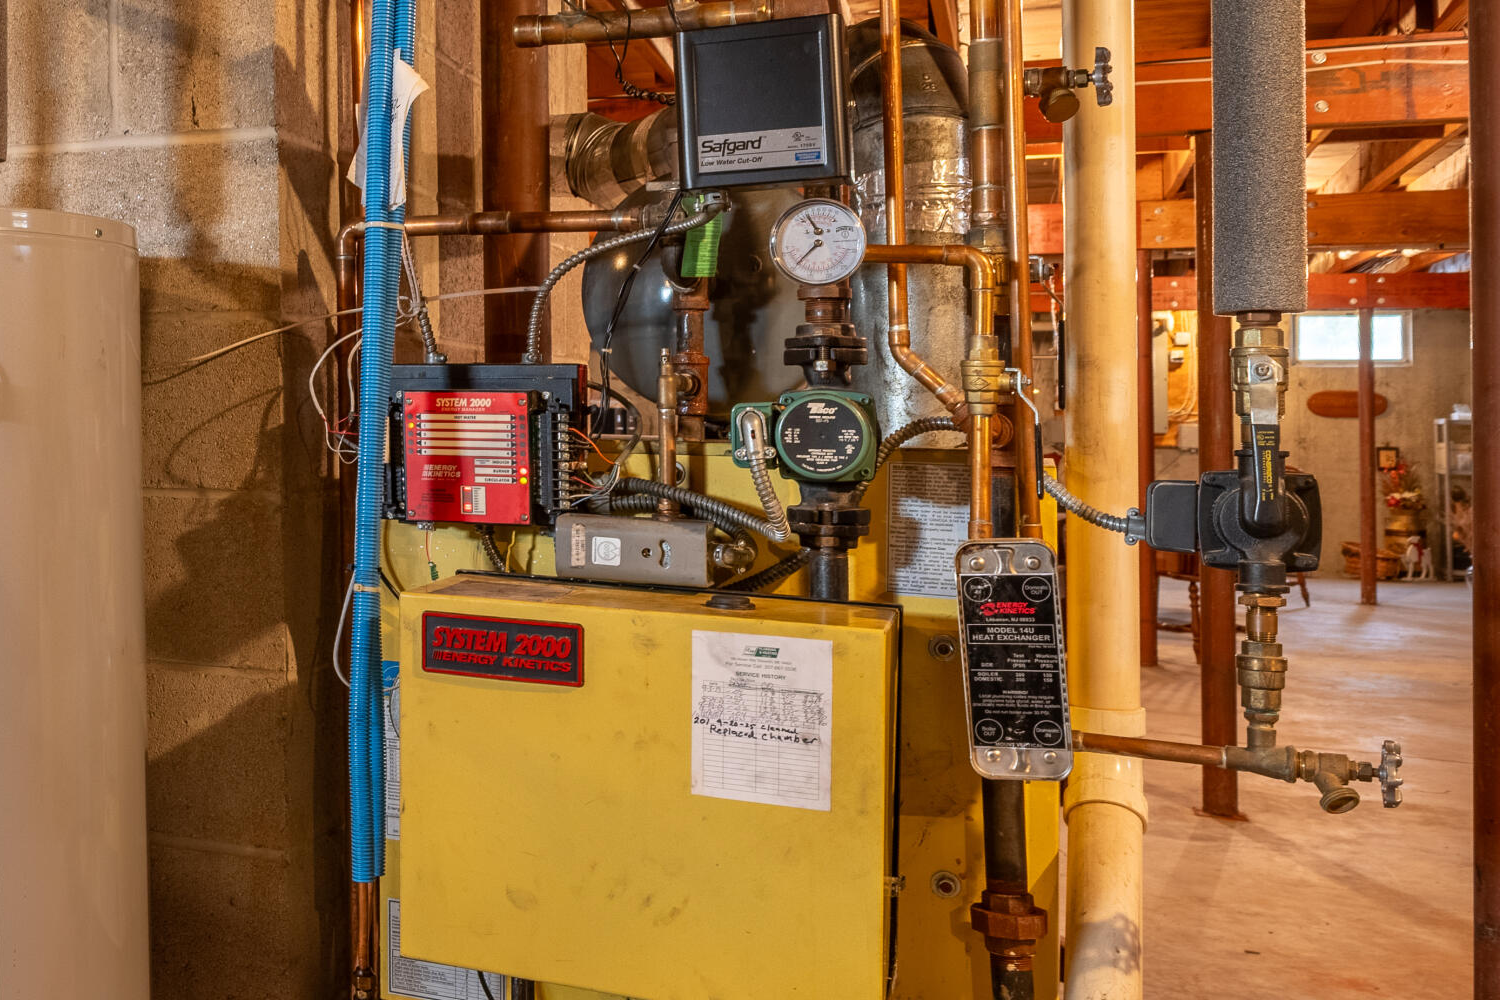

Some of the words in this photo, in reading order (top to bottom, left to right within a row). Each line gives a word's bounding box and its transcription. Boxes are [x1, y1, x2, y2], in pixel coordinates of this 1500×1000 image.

[701, 136, 762, 156] Safgard
[738, 156, 763, 164] Cut-Off
[436, 398, 467, 408] SYSTEM
[470, 399, 491, 408] 2000
[432, 626, 508, 653] SYSTEM
[514, 633, 572, 659] 2000
[442, 651, 498, 665] ENERGY
[502, 656, 572, 672] KINETICS
